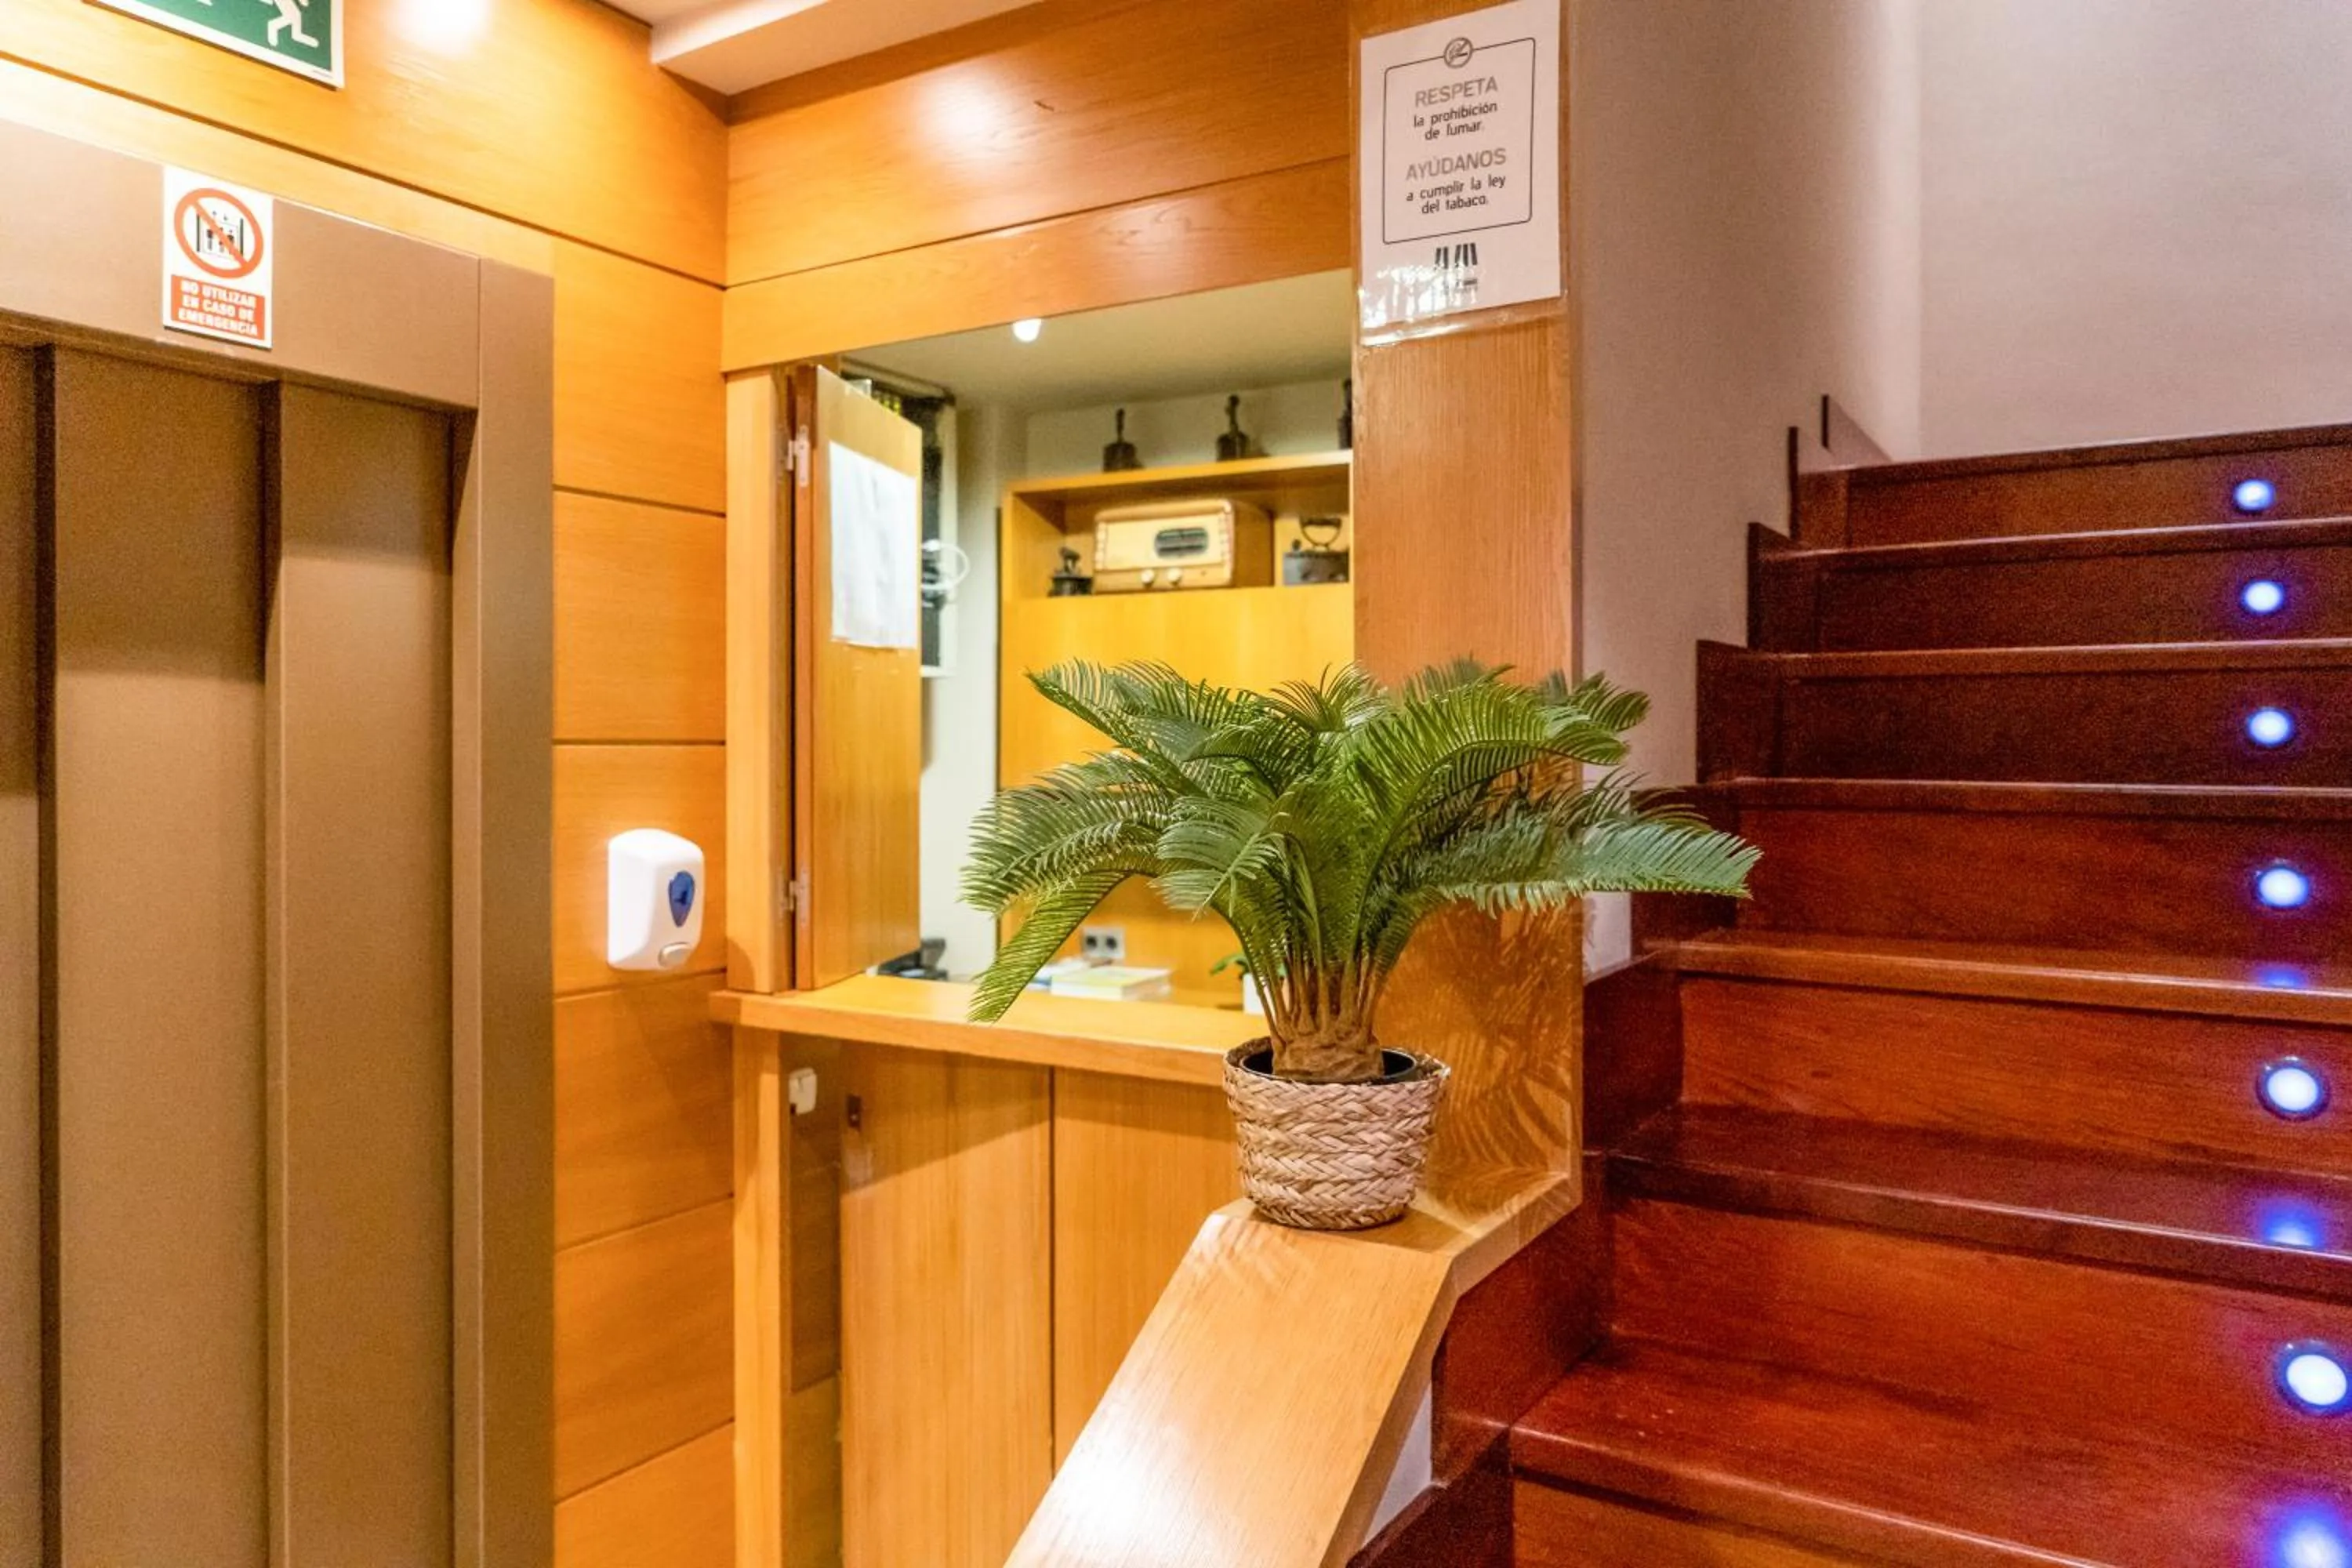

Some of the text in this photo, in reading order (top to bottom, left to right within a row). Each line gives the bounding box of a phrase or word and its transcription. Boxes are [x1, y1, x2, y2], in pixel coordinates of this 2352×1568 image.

[1415, 75, 1498, 107] RESPETA
[1414, 102, 1497, 127] la prohibición
[1425, 127, 1440, 140] de
[1406, 147, 1506, 180] AYÚDANOS
[1406, 173, 1506, 201] a cumplir la ley
[1421, 199, 1440, 214] del
[181, 279, 256, 308] NO UTILIZAR
[183, 293, 254, 322] EN CASO DE
[178, 307, 259, 336] EMERGENCIA
